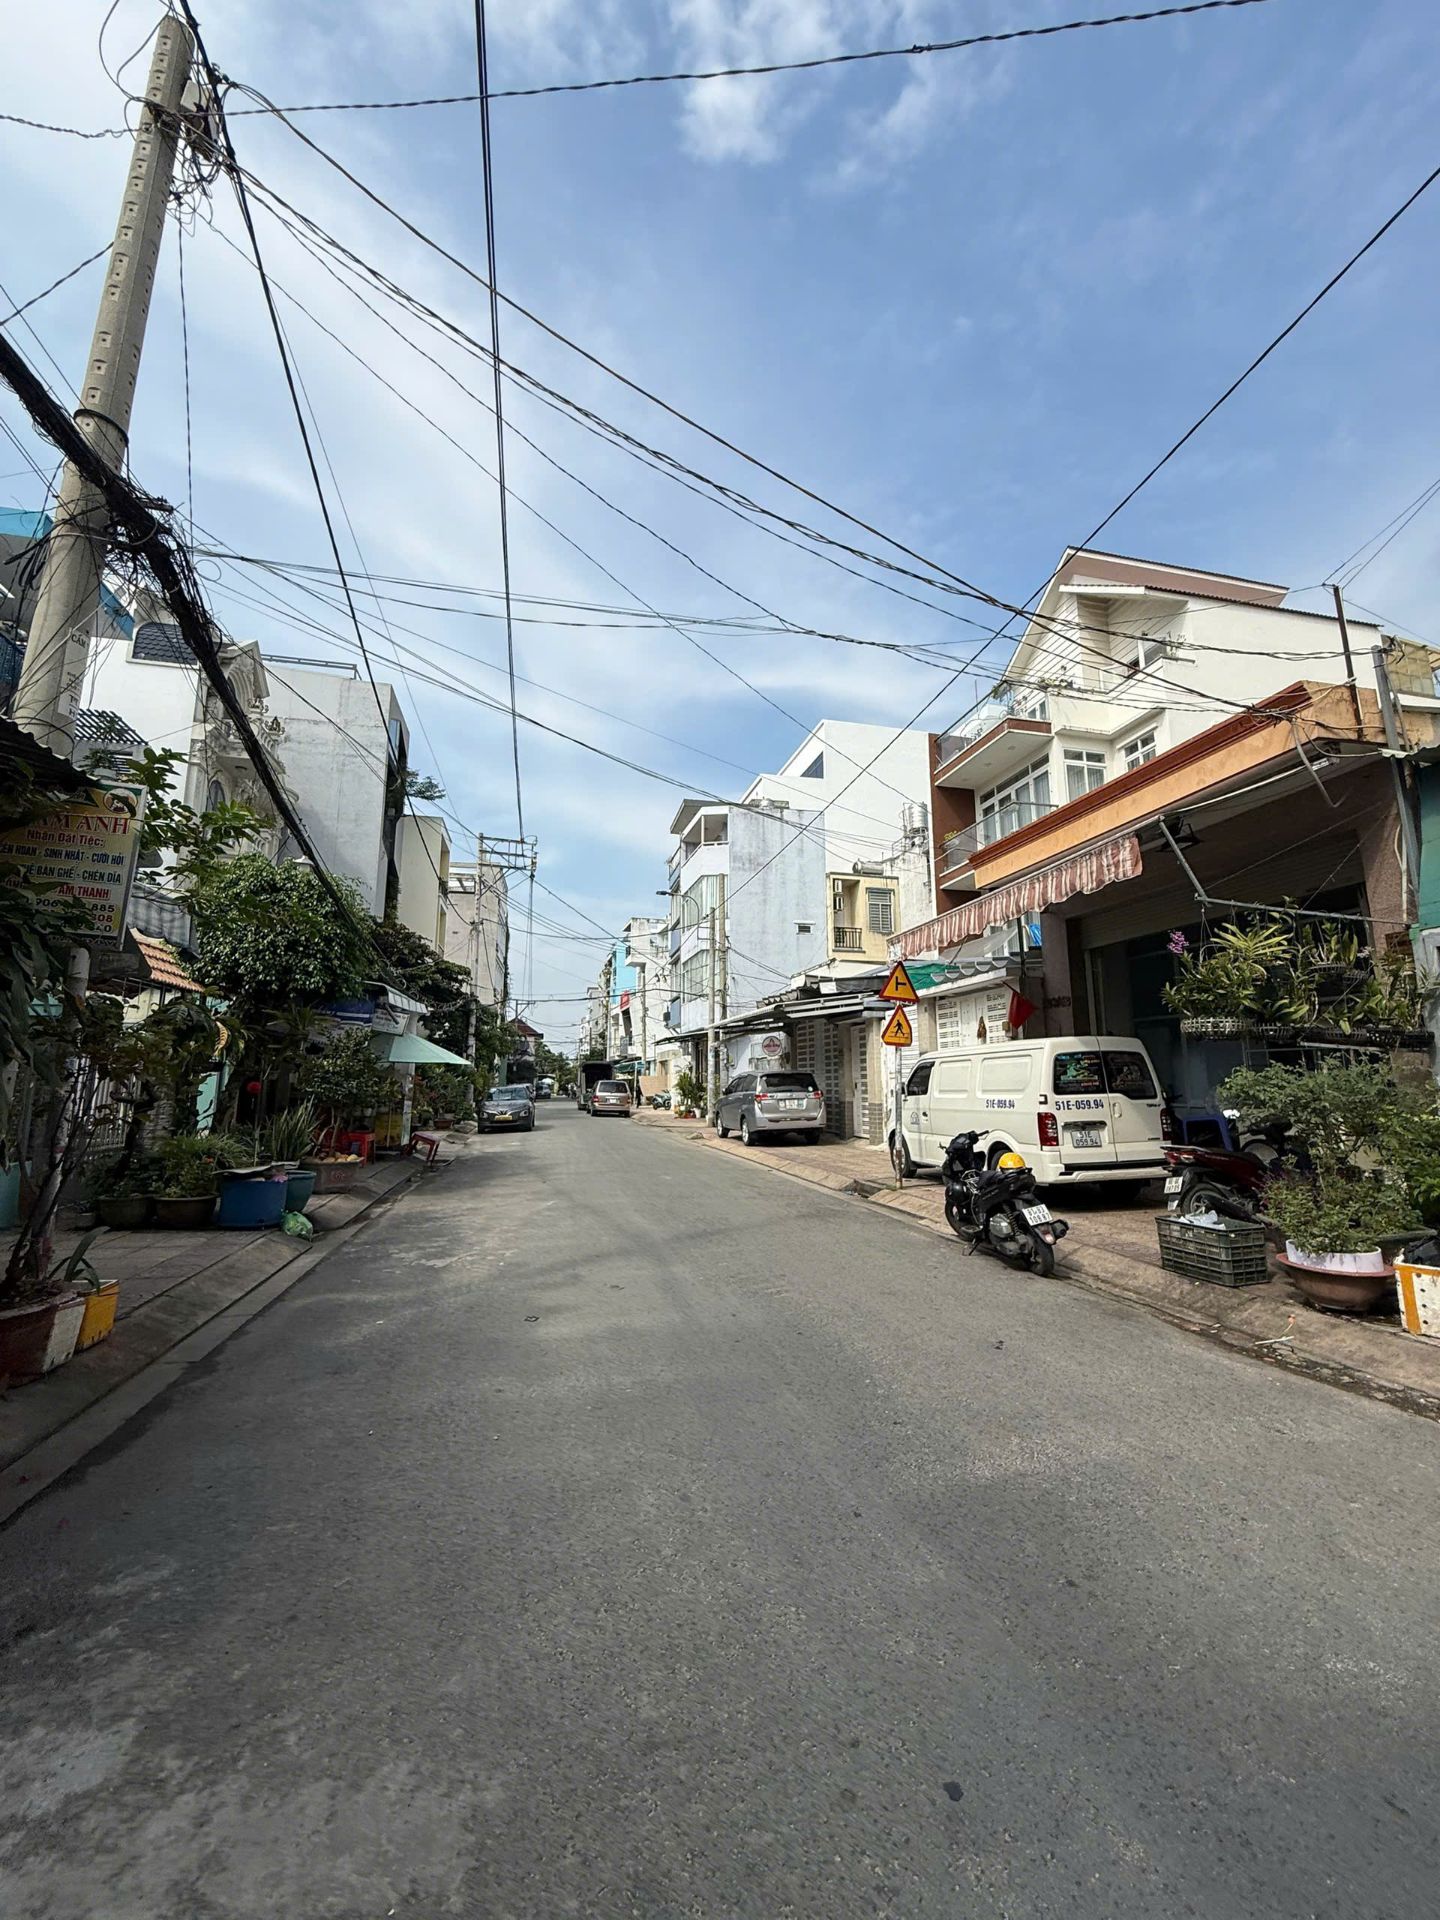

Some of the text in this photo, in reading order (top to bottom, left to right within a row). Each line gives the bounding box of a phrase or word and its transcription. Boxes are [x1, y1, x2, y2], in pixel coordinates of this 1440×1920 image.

[77, 885, 109, 898] THANH
[985, 1099, 1015, 1110] 51E-059.94
[1055, 1099, 1104, 1111] 51E-059.94
